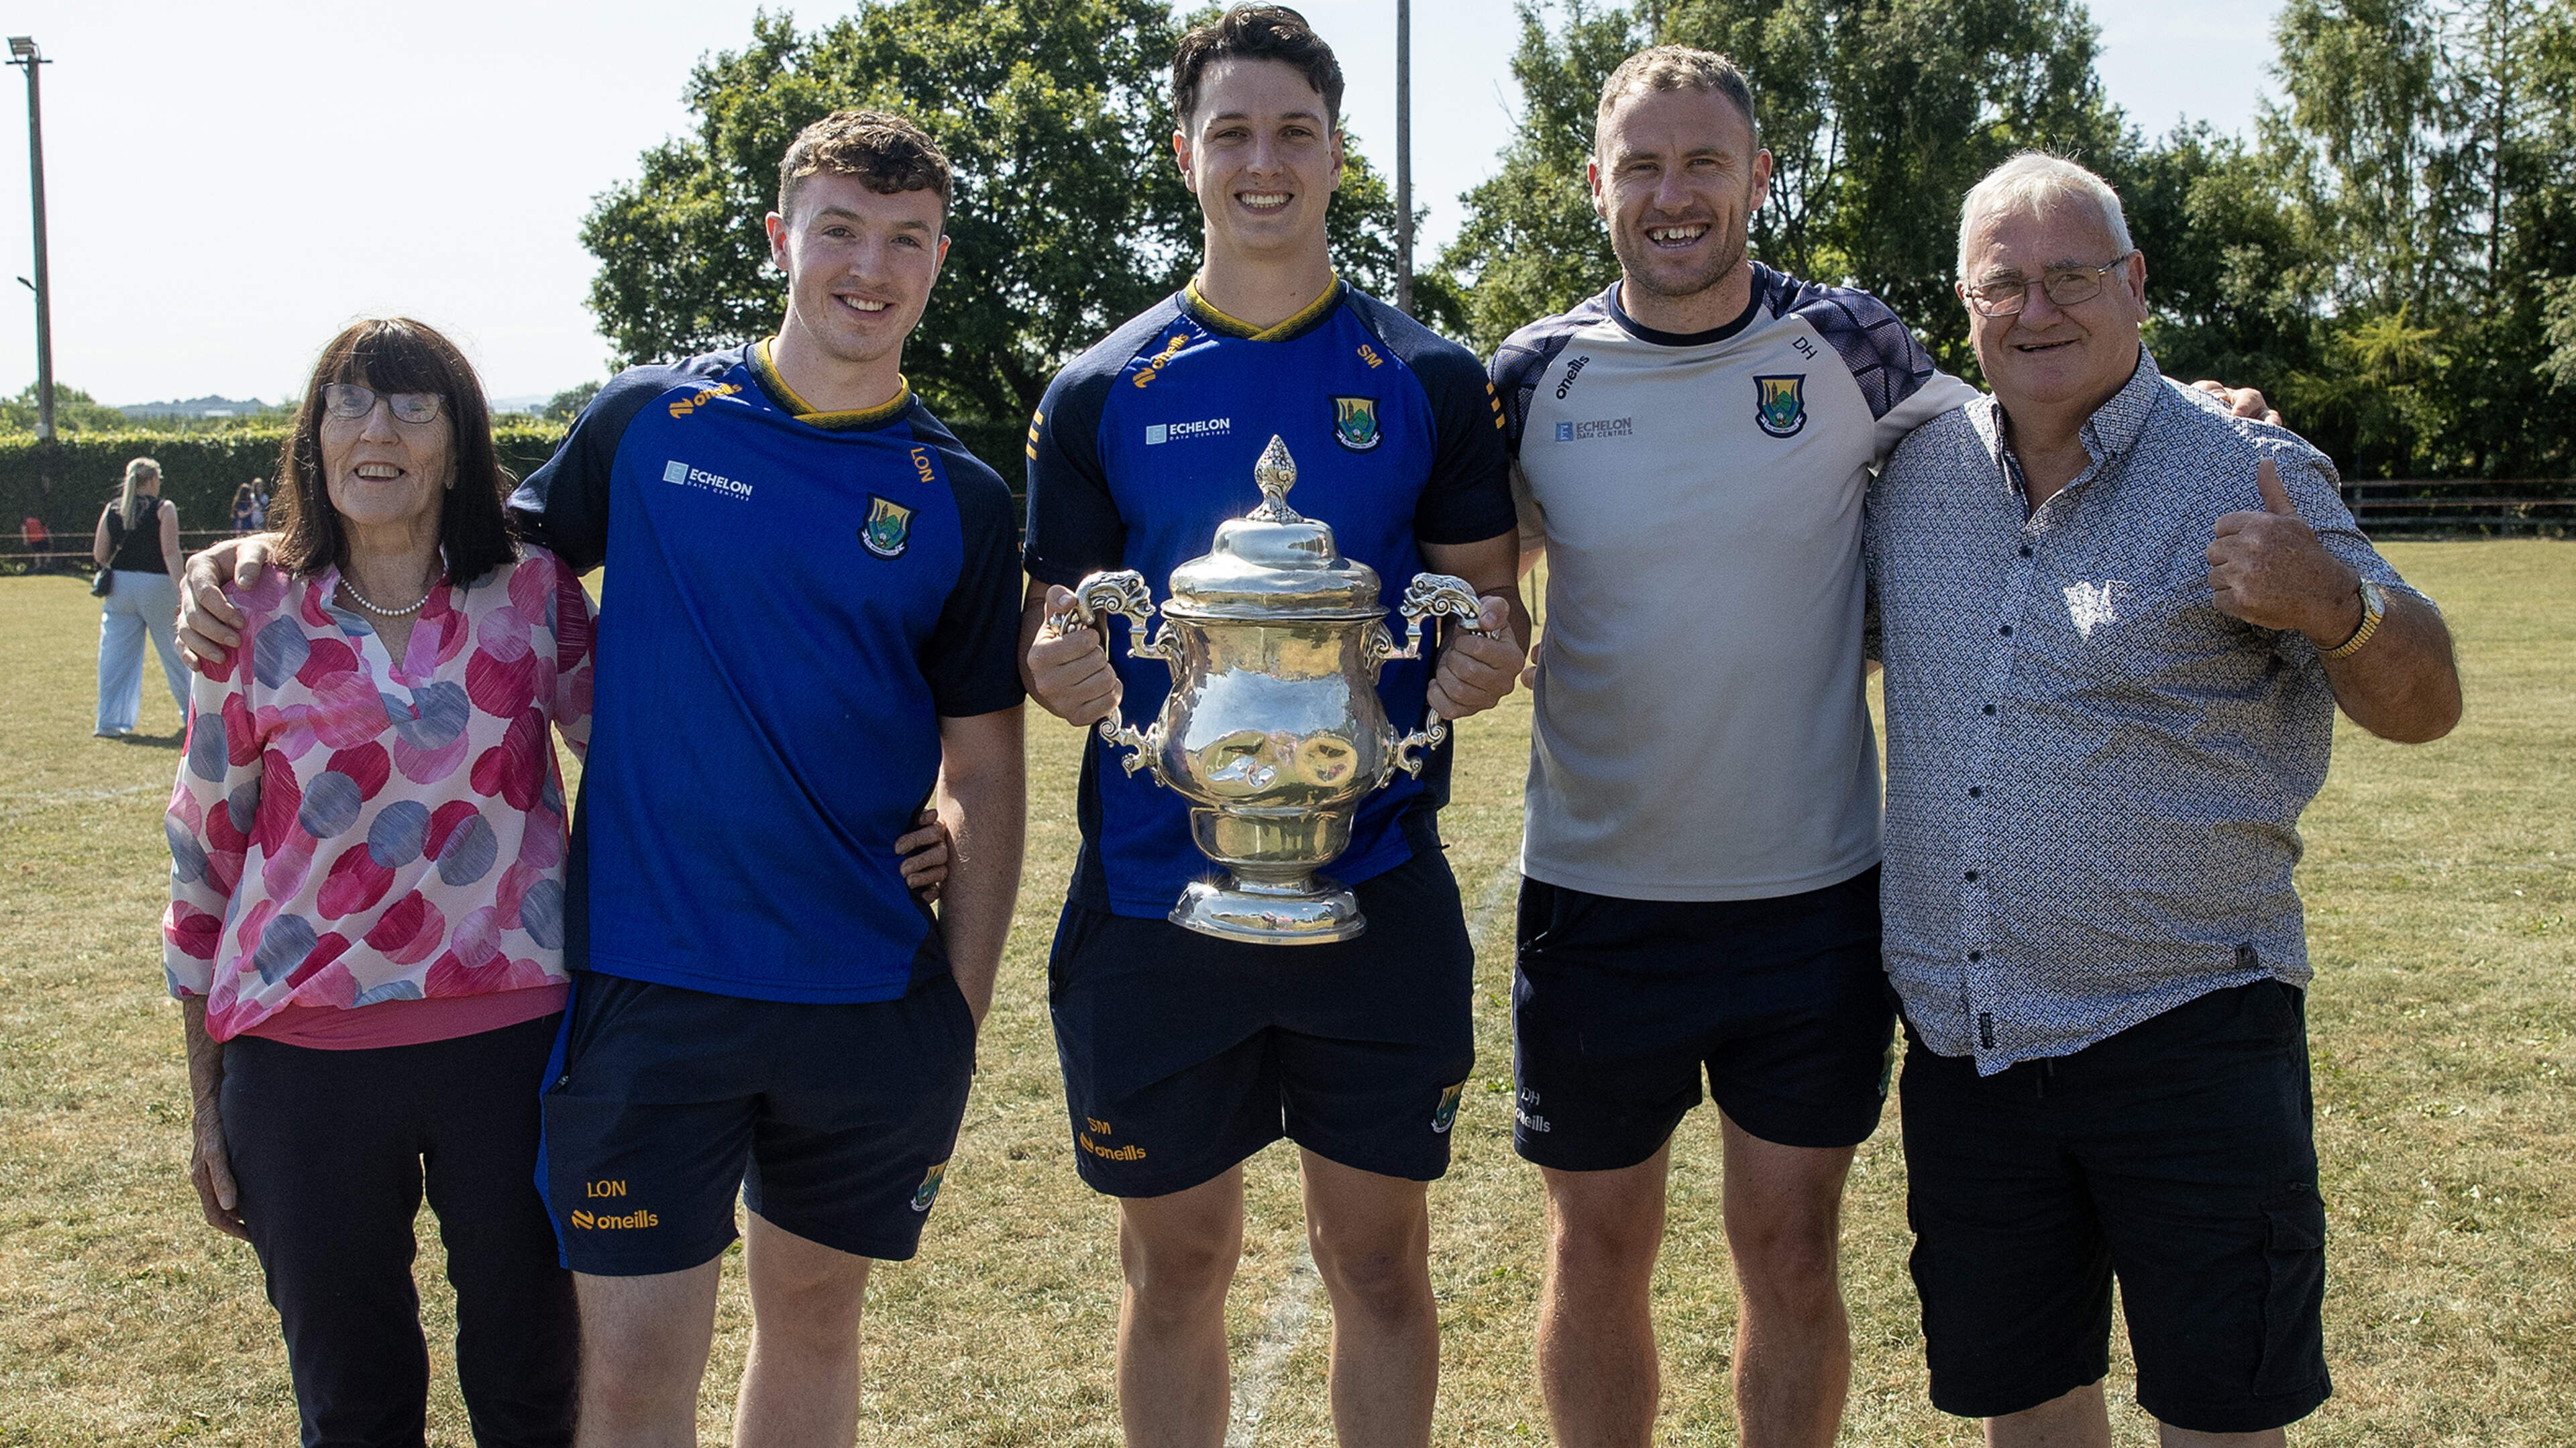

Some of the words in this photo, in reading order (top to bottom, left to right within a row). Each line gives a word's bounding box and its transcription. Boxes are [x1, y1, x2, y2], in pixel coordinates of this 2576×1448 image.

[1357, 344, 1383, 369] SM
[1792, 336, 1818, 360] DH
[1556, 355, 1590, 400] o'neills
[1170, 417, 1230, 435] ECHELON
[1576, 417, 1631, 433] ECHELON
[1576, 432, 1594, 440] DATA
[1597, 429, 1633, 438] CENTRES
[910, 447, 935, 483] LON
[689, 468, 753, 496] ECHELON
[1521, 1087, 1540, 1106] DH
[1087, 1117, 1112, 1135] SM
[587, 1180, 627, 1198] LON
[597, 1210, 659, 1230] o'neills
